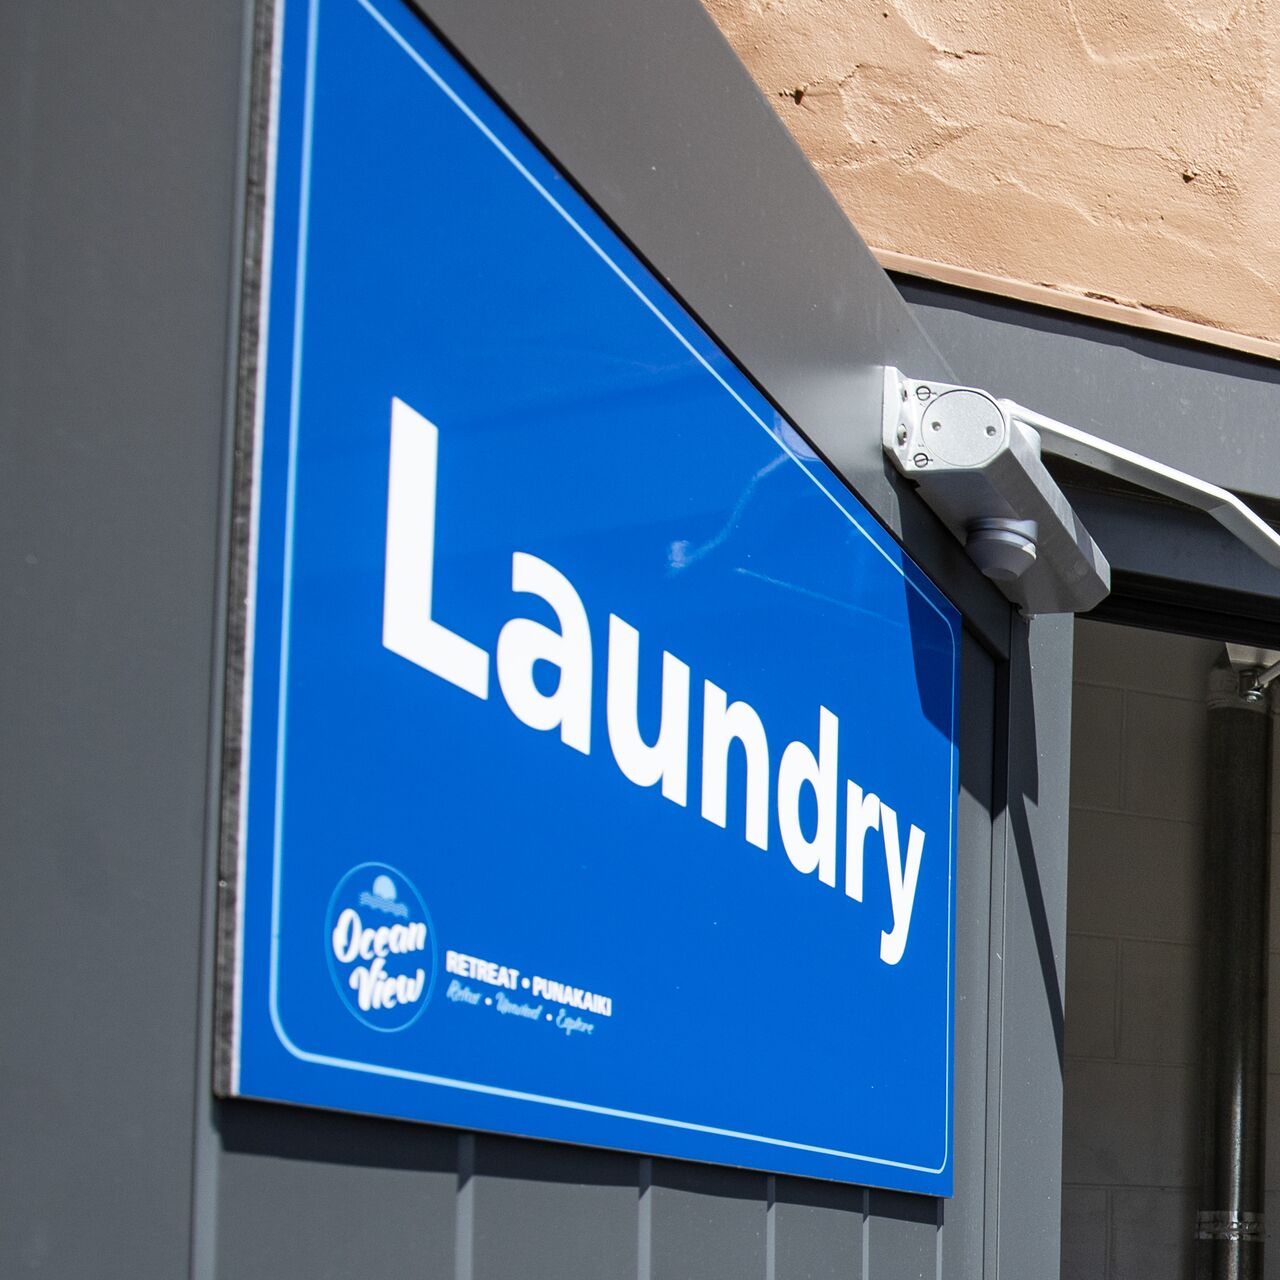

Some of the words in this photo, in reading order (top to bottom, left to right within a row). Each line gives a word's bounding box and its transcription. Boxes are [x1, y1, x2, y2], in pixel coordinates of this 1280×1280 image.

[383, 396, 925, 966] Laundry
[332, 908, 427, 963] Ocean
[349, 957, 425, 1011] View
[446, 950, 520, 990] RETREAT
[532, 975, 612, 1017] PUNAKAIKI
[556, 1008, 594, 1036] Explore
